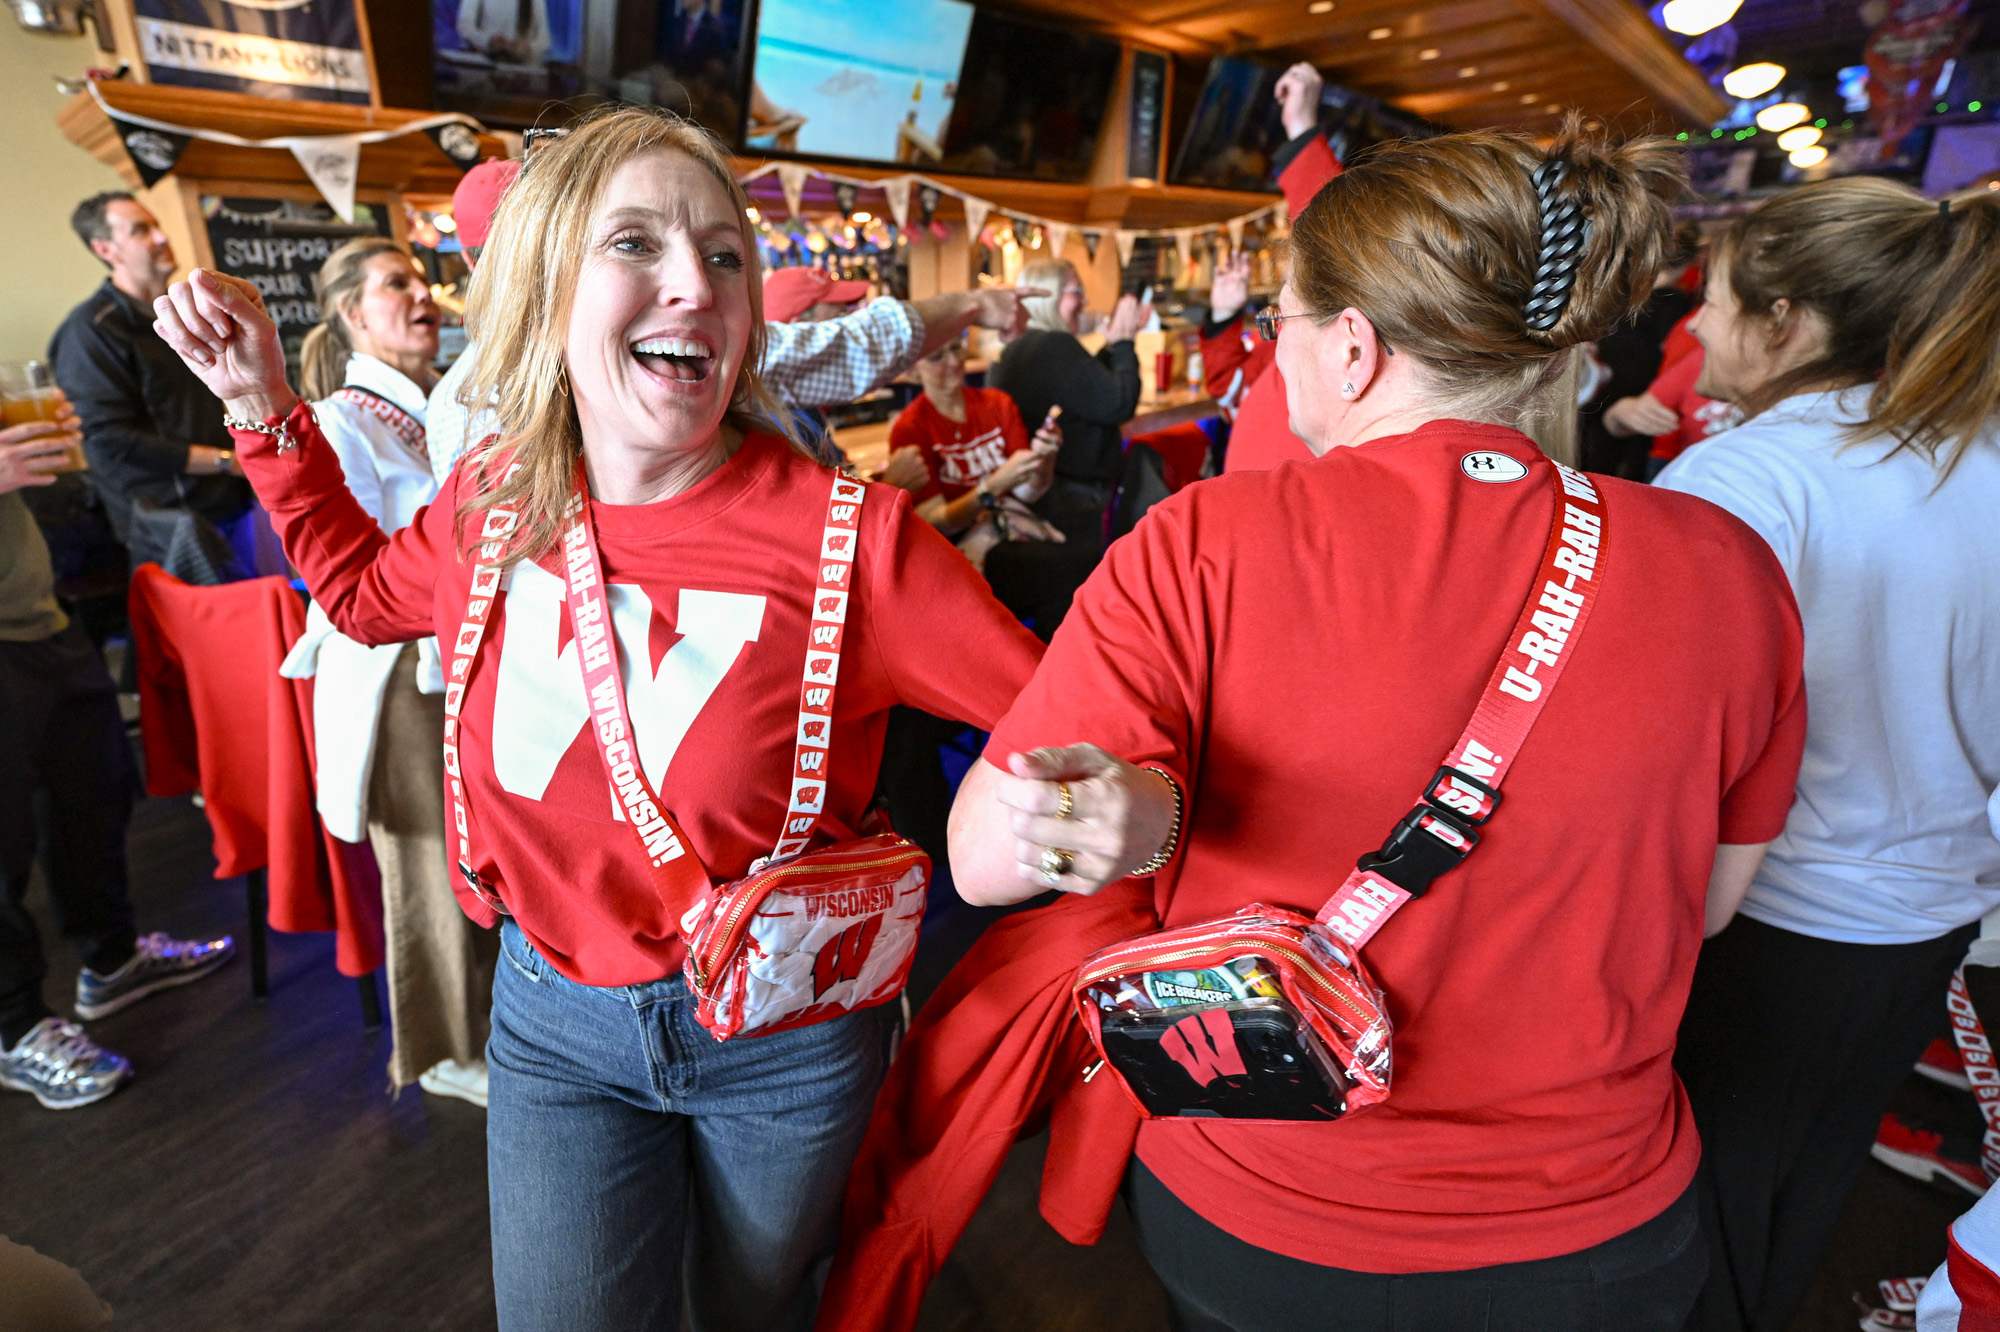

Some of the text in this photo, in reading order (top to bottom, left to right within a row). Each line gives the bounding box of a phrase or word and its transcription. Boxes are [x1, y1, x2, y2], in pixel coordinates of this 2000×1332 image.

[1499, 502, 1601, 702] U-RAH-RAH
[491, 557, 767, 822] W
[591, 674, 686, 869] WISCONSIN!
[803, 884, 895, 922] WISCONSIN
[810, 912, 884, 1003] W
[1154, 980, 1233, 1003] ICE BREAKERS
[1159, 1008, 1247, 1087] W
